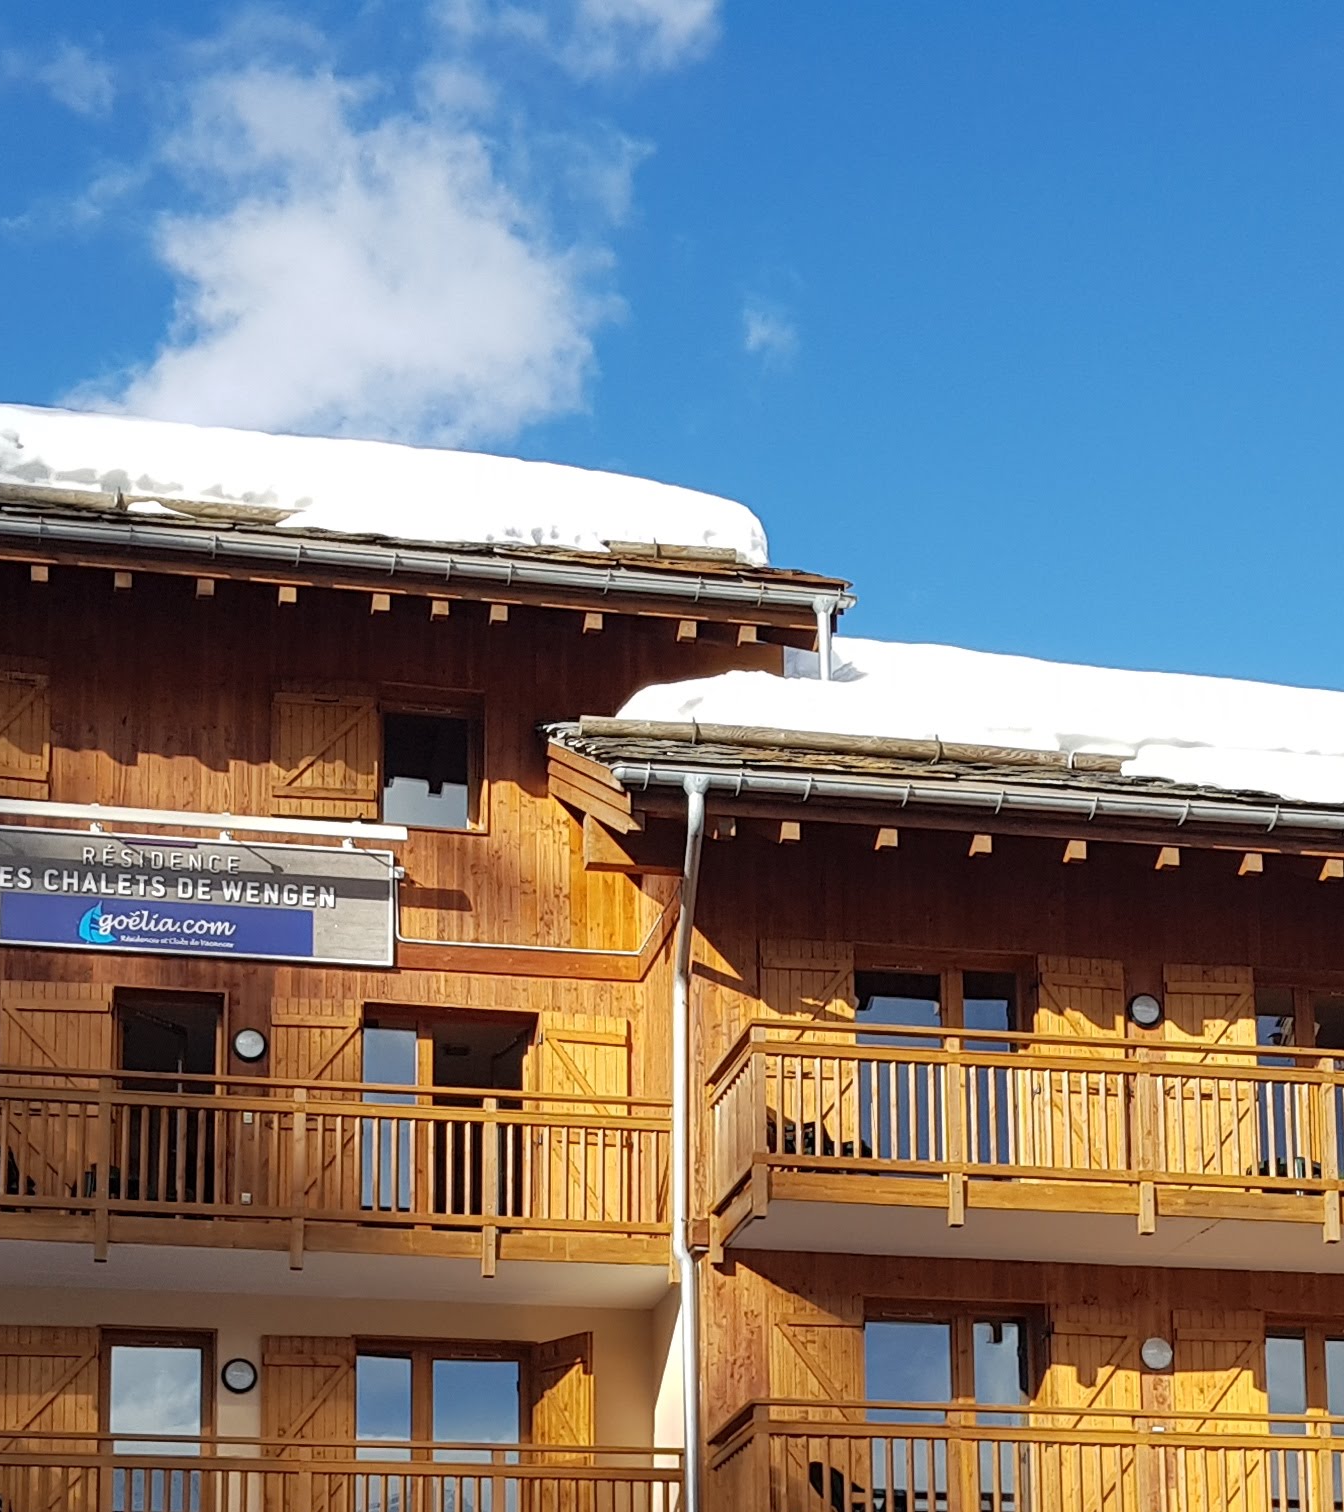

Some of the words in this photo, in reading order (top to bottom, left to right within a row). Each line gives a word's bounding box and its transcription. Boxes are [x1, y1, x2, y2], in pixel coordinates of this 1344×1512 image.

[82, 844, 241, 875] RÉSIDENCE
[44, 869, 167, 898] CHALETS
[177, 877, 212, 900] DE
[221, 880, 336, 908] WENGEN
